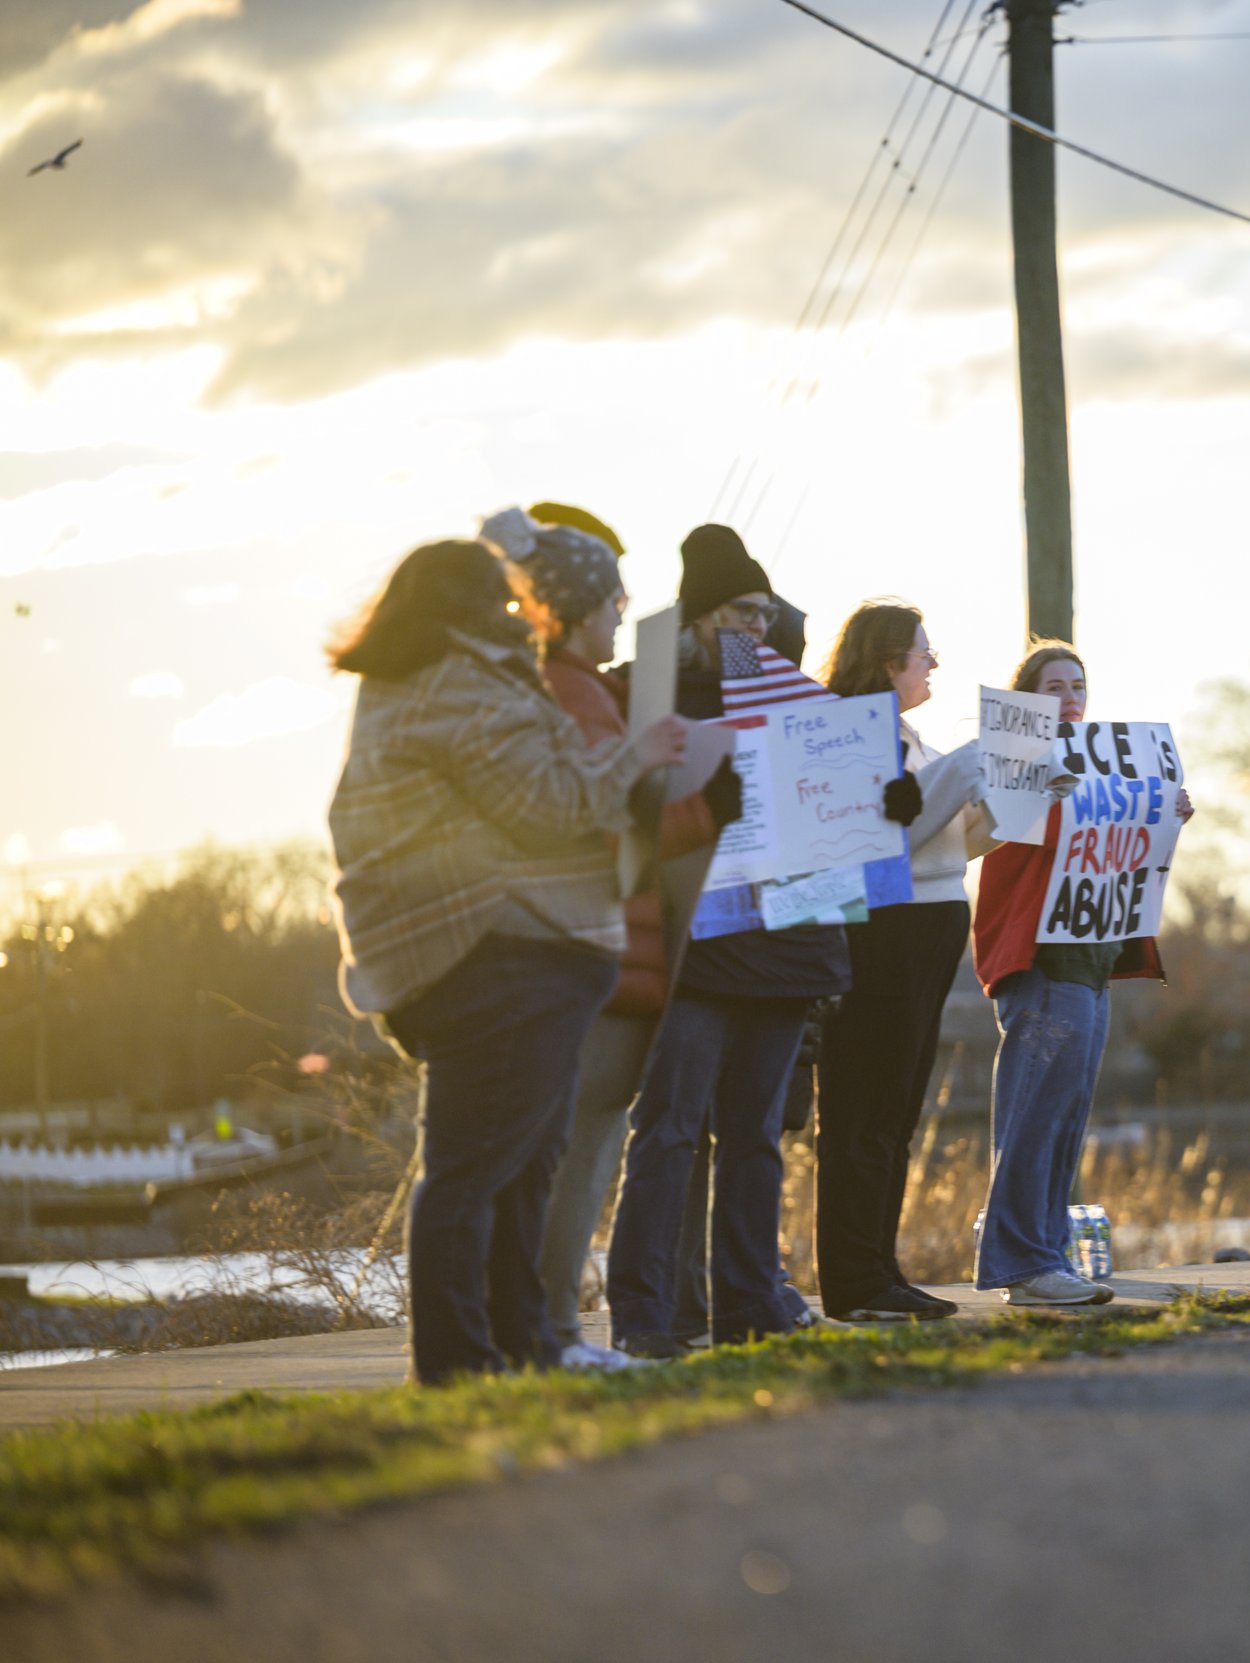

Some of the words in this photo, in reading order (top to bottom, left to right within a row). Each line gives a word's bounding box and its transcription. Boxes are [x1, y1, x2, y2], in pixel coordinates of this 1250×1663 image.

[784, 714, 828, 740] Free
[803, 728, 865, 757] Speech
[1056, 722, 1138, 779] ICE
[796, 777, 834, 805] Free
[1072, 773, 1163, 826] WASTE
[816, 802, 881, 823] Country
[1063, 823, 1150, 875] FRAUD
[1046, 866, 1149, 941] ABUSE
